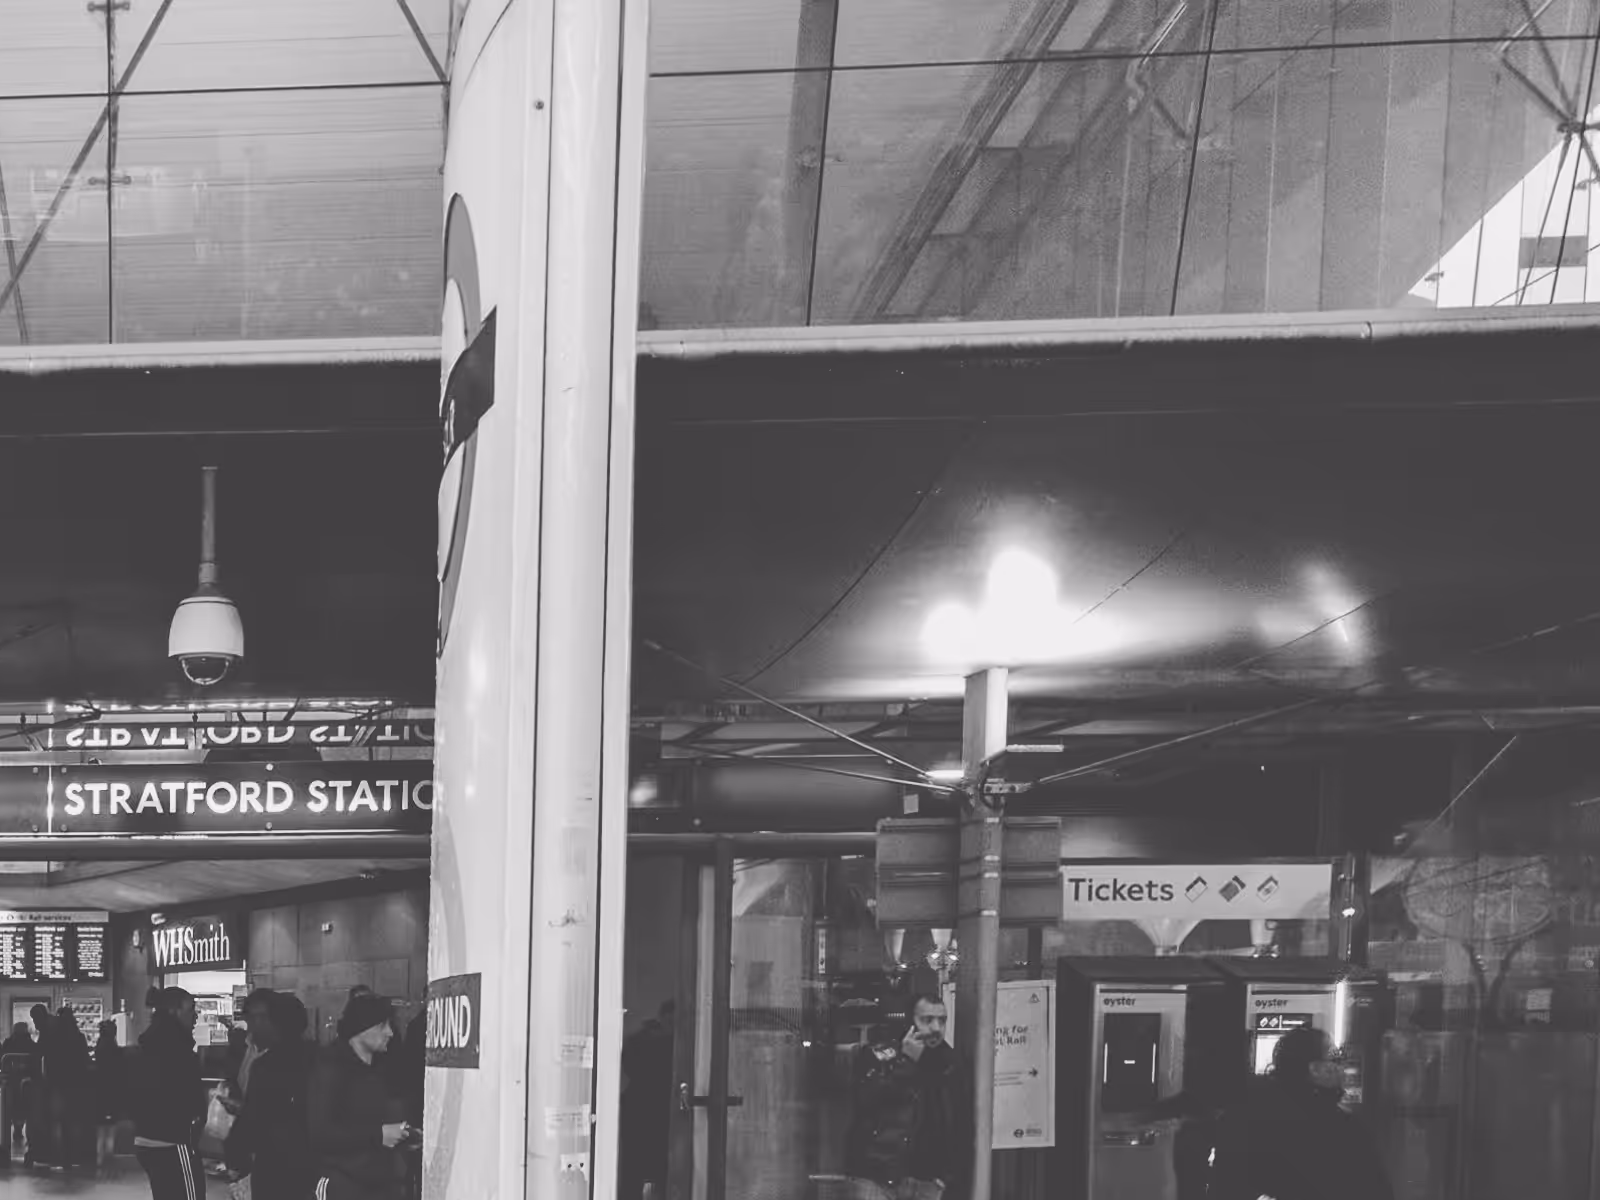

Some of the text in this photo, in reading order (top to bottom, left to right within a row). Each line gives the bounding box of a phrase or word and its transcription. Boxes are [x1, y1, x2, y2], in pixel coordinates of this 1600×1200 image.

[63, 781, 295, 815] STRATFORD
[1068, 878, 1174, 902] Tickets
[152, 922, 231, 968] WHSmith
[1103, 996, 1136, 1007] oyster
[1254, 998, 1289, 1008] oyster
